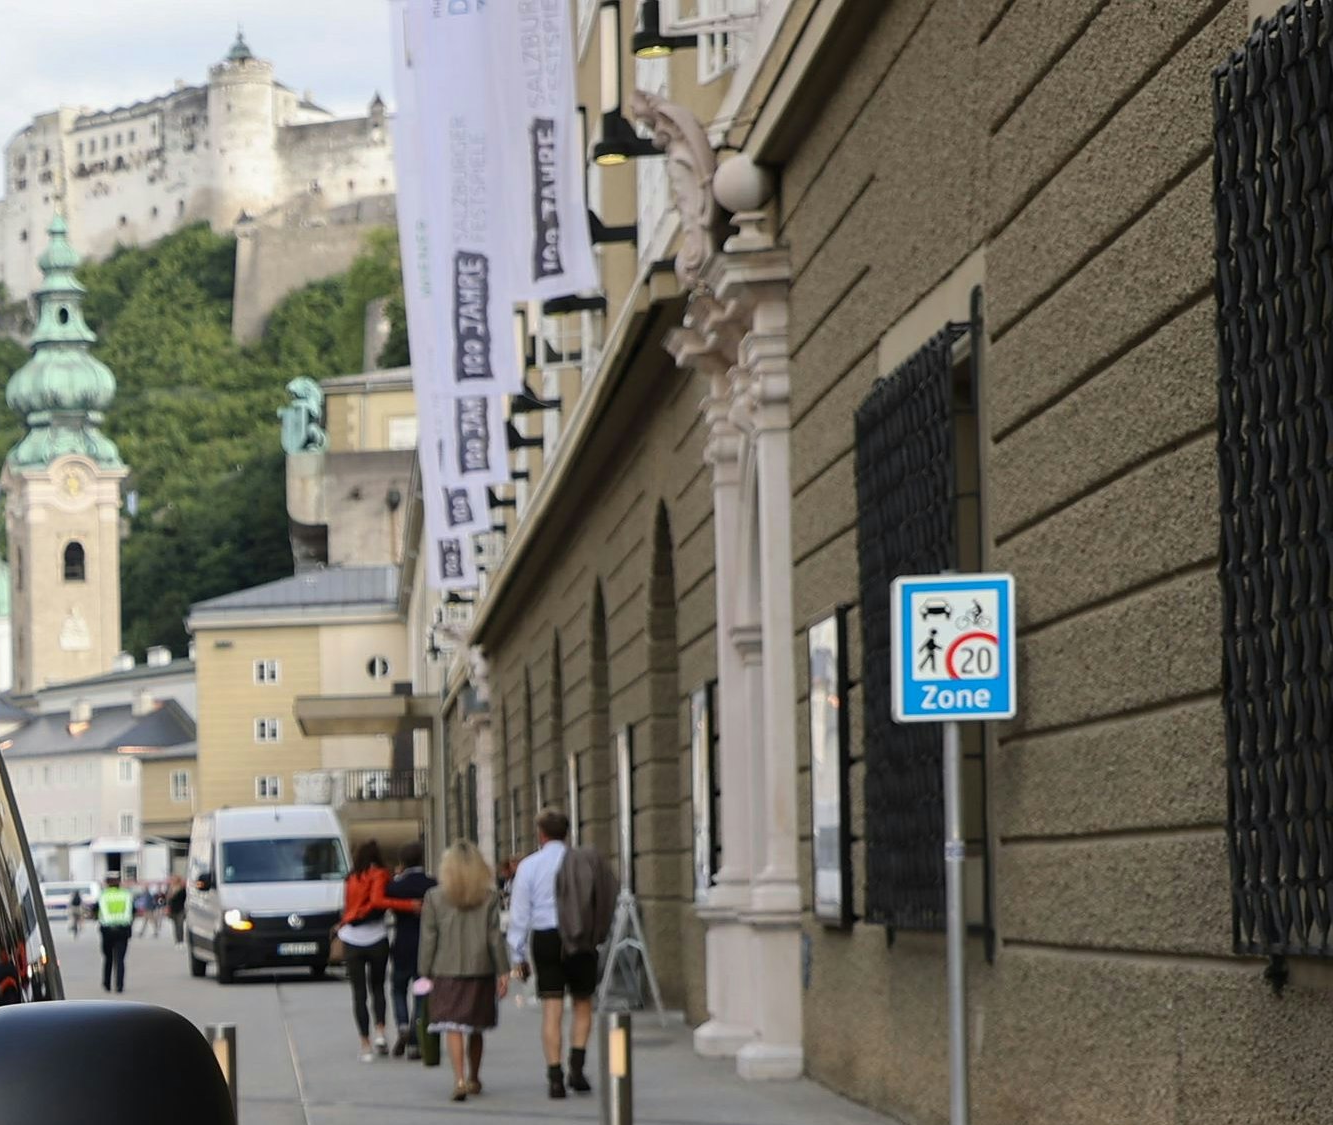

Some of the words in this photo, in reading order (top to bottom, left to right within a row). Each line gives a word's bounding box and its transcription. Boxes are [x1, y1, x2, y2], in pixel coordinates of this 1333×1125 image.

[457, 257, 485, 336] JAHRE
[461, 338, 484, 376] 100
[465, 438, 483, 471] 100
[960, 647, 992, 674] 20
[920, 684, 992, 710] Zone
